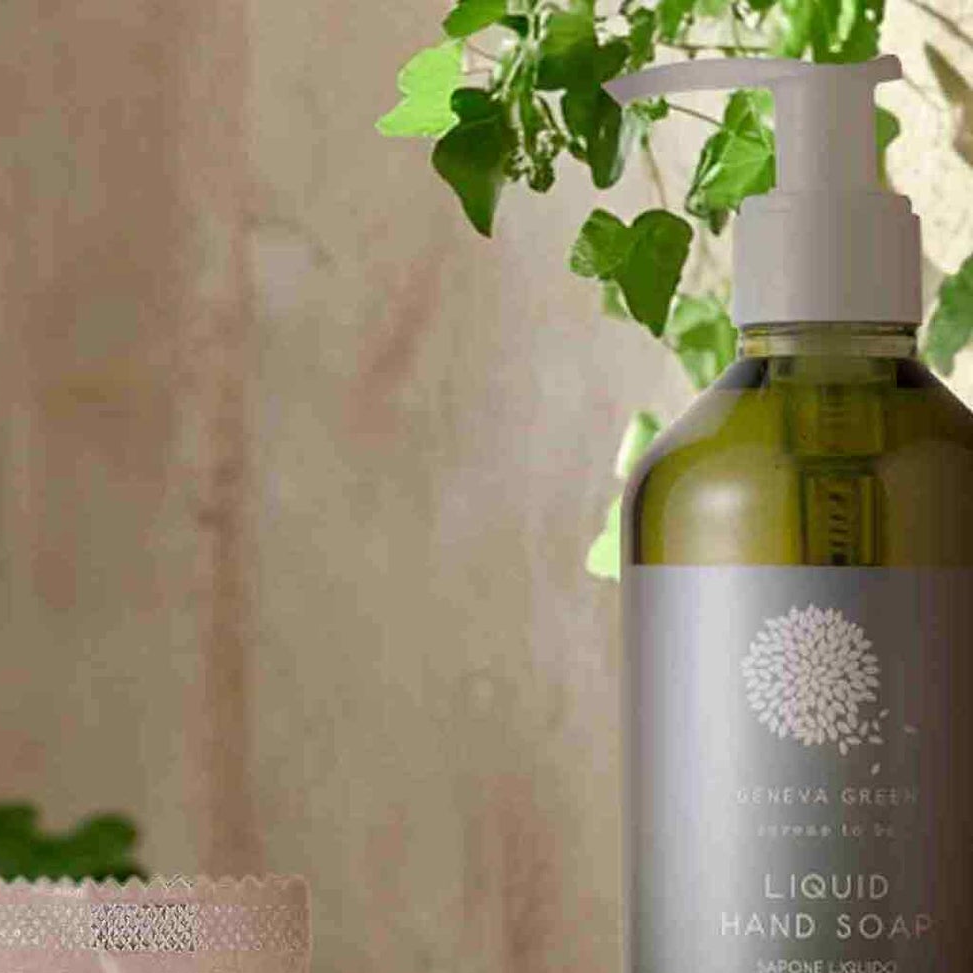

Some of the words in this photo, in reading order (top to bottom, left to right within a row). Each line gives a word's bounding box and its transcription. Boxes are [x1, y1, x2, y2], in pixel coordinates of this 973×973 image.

[737, 786, 829, 804] GENEVA
[763, 873, 889, 900] LIQUID
[719, 912, 816, 938] HAND
[835, 912, 933, 939] SOAP
